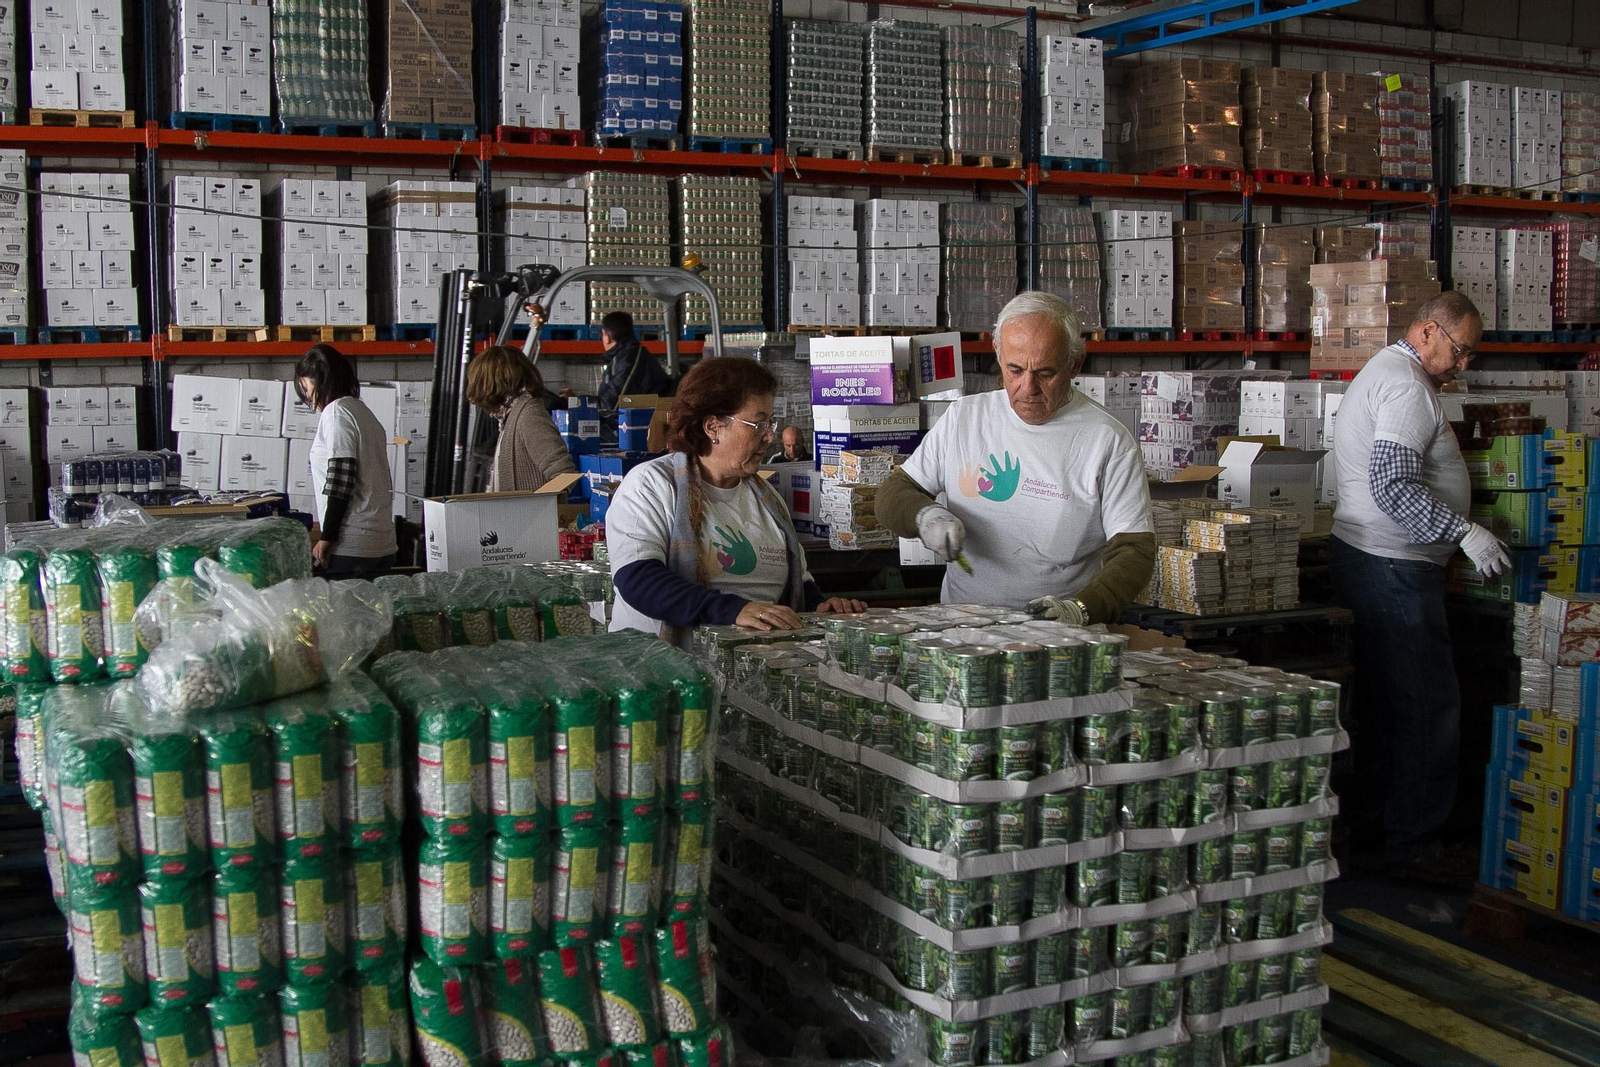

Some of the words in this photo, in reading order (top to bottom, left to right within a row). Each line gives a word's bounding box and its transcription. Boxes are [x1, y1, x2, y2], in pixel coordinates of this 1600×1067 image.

[835, 378, 866, 387] INES
[821, 387, 882, 397] ROSALES
[1024, 477, 1058, 489] Andaluces
[1021, 485, 1070, 500] Compartiendo
[482, 546, 513, 555] Andaluces
[482, 552, 527, 562] Compartiendo
